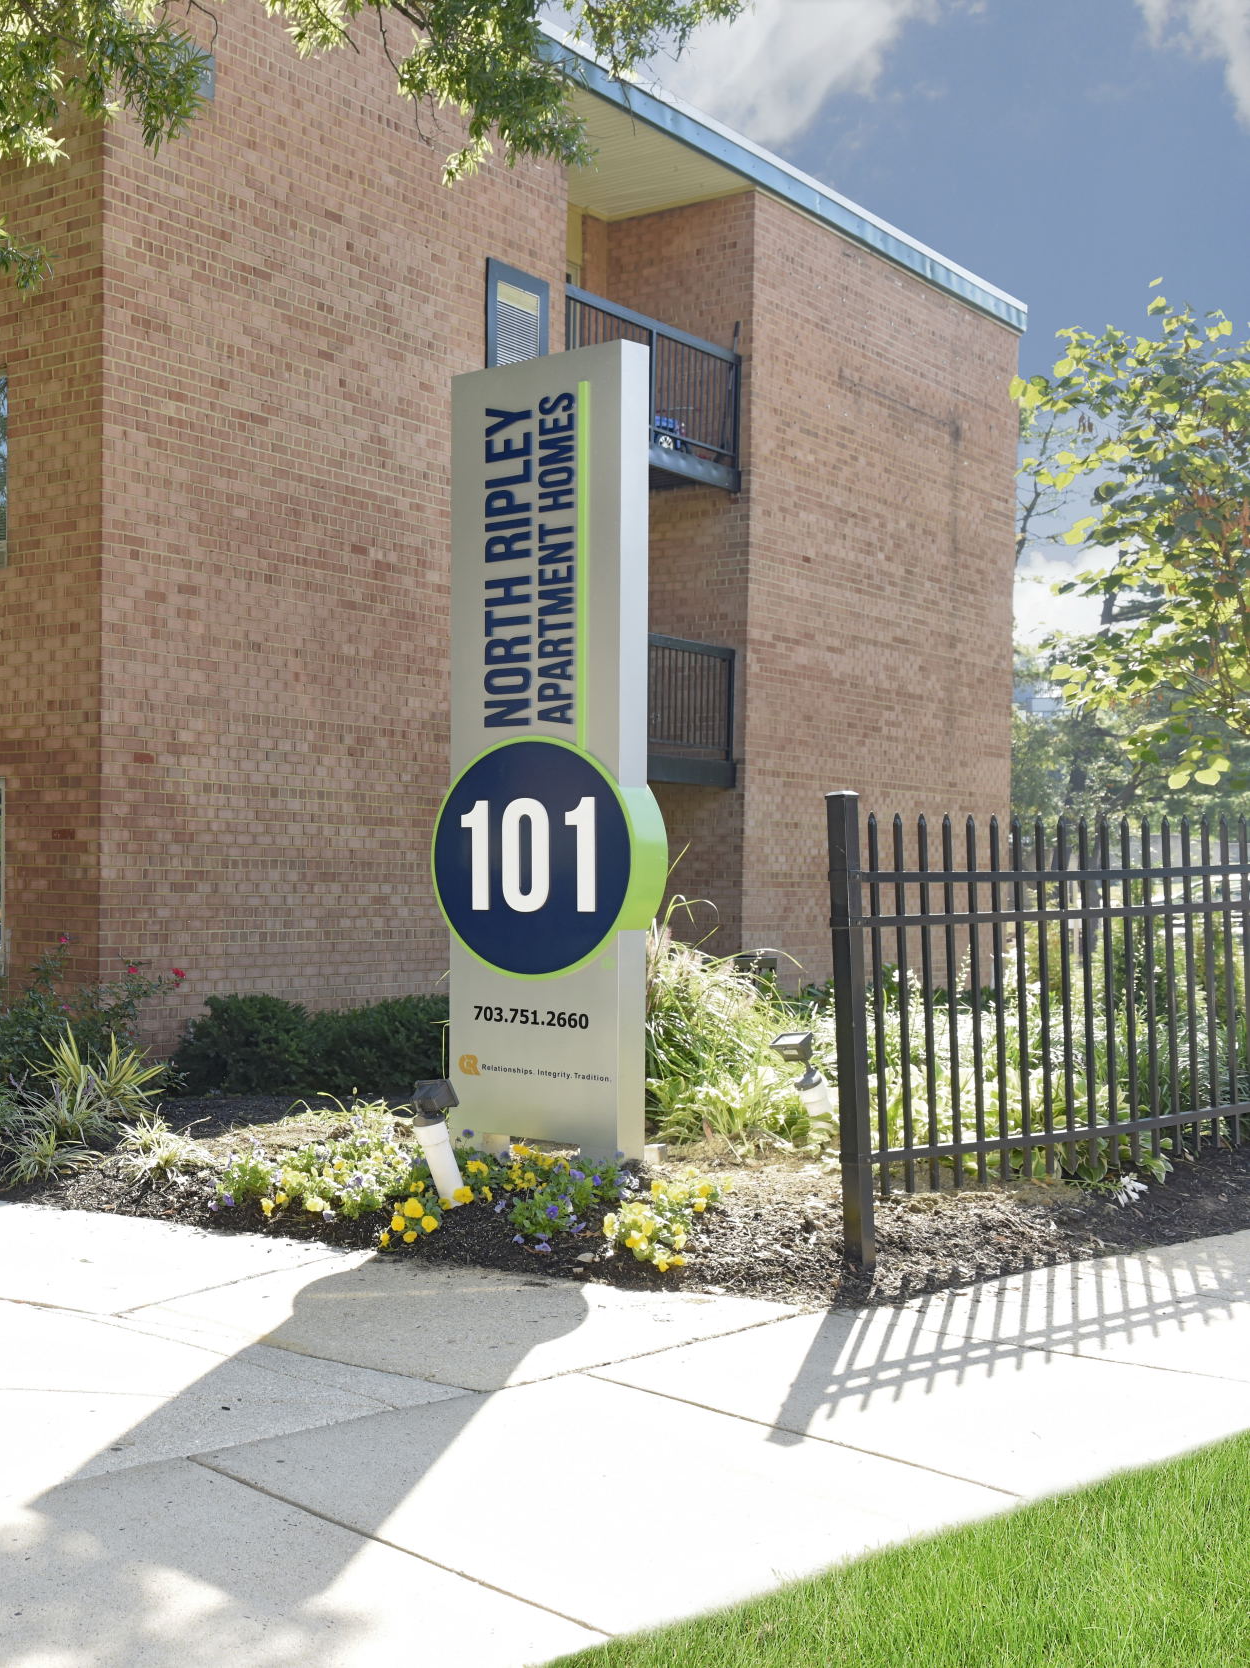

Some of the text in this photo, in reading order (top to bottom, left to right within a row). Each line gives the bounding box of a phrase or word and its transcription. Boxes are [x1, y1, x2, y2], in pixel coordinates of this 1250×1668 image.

[484, 407, 533, 728] NORTH RIPLEY
[537, 391, 576, 725] APARTMENT HOMES
[460, 796, 596, 913] 101
[473, 1005, 589, 1030] 703.751.2660
[481, 1063, 612, 1083] Relationships. Integrity. Tradition.
